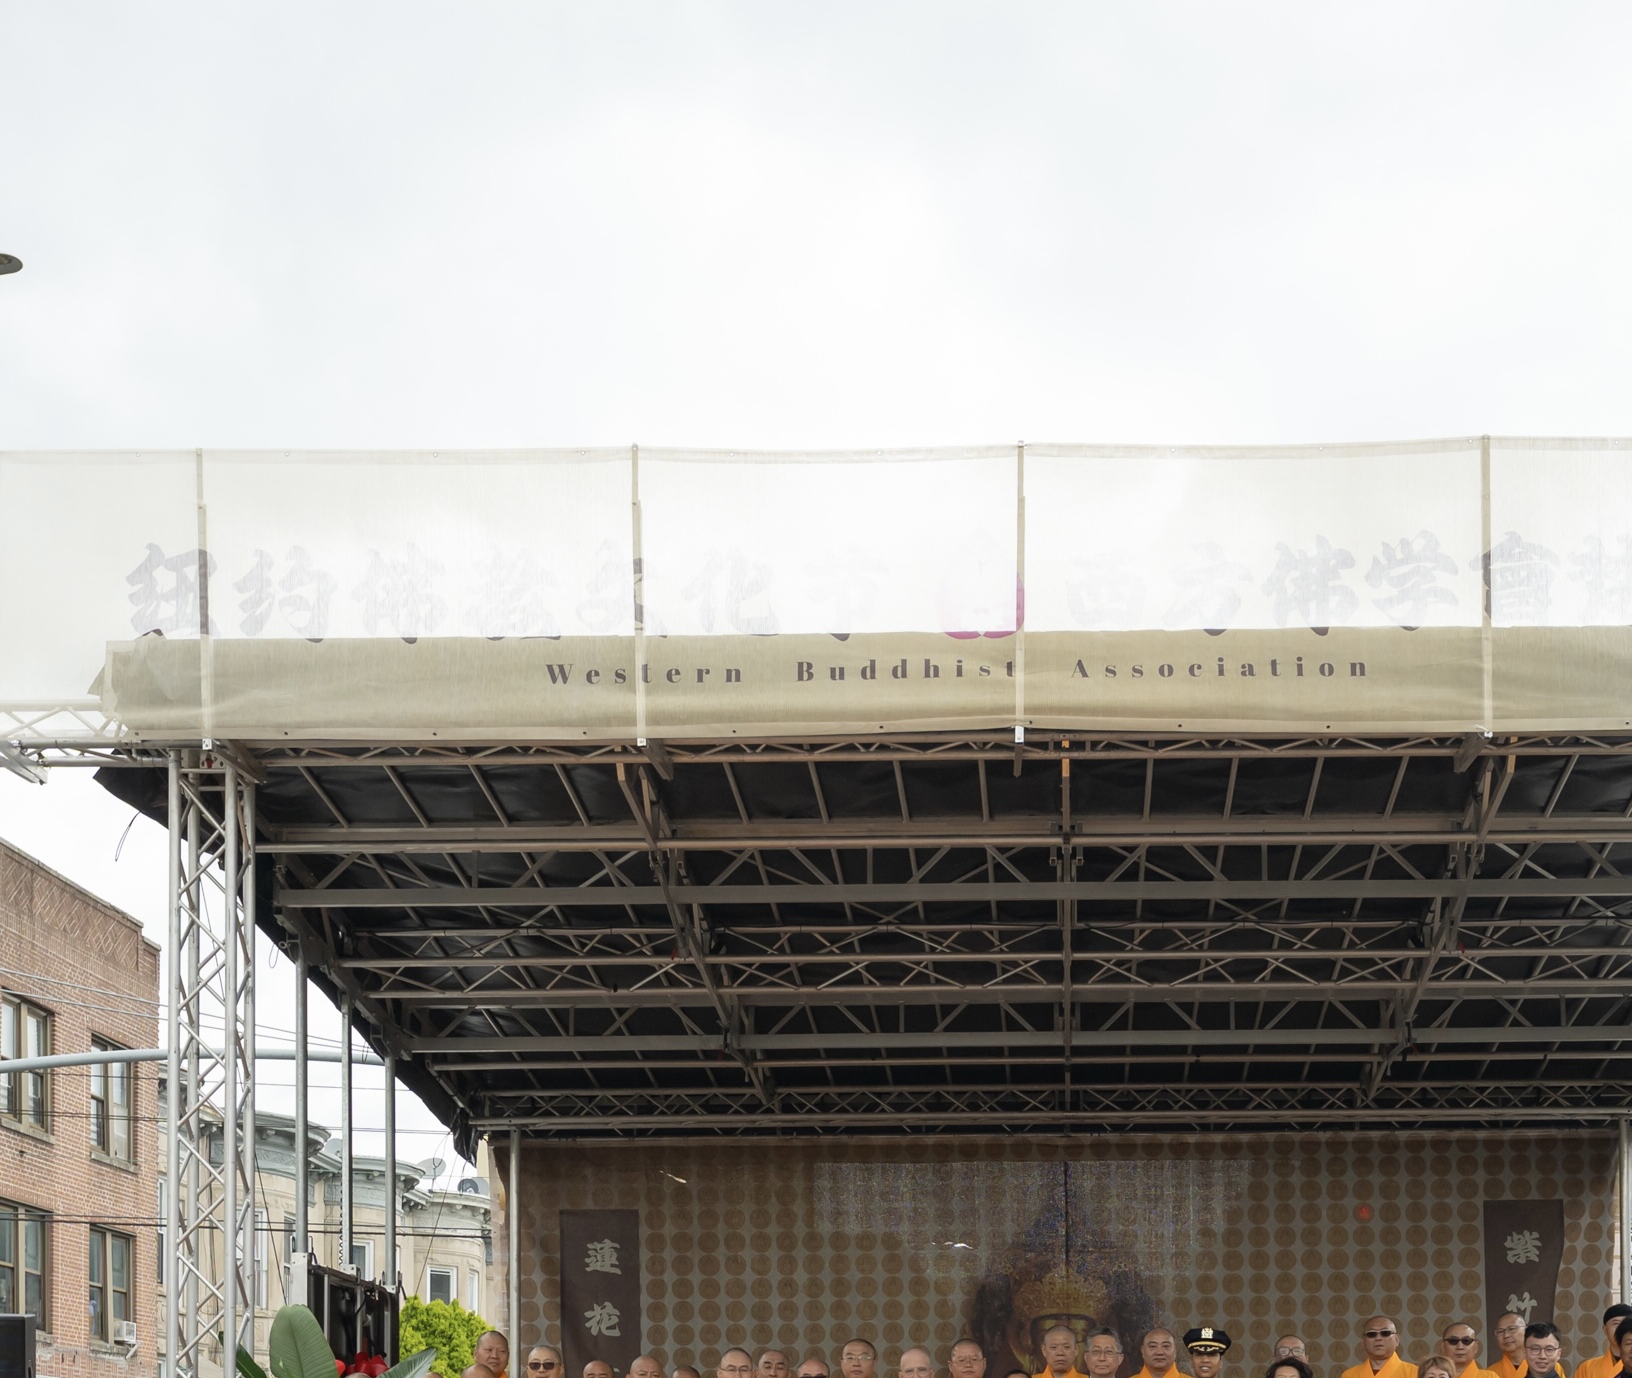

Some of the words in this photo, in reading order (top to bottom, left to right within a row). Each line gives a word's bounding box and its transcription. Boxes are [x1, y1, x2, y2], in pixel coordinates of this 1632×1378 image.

[545, 660, 745, 687] Western
[795, 657, 1018, 683] Buddhist
[1070, 655, 1368, 679] Association
